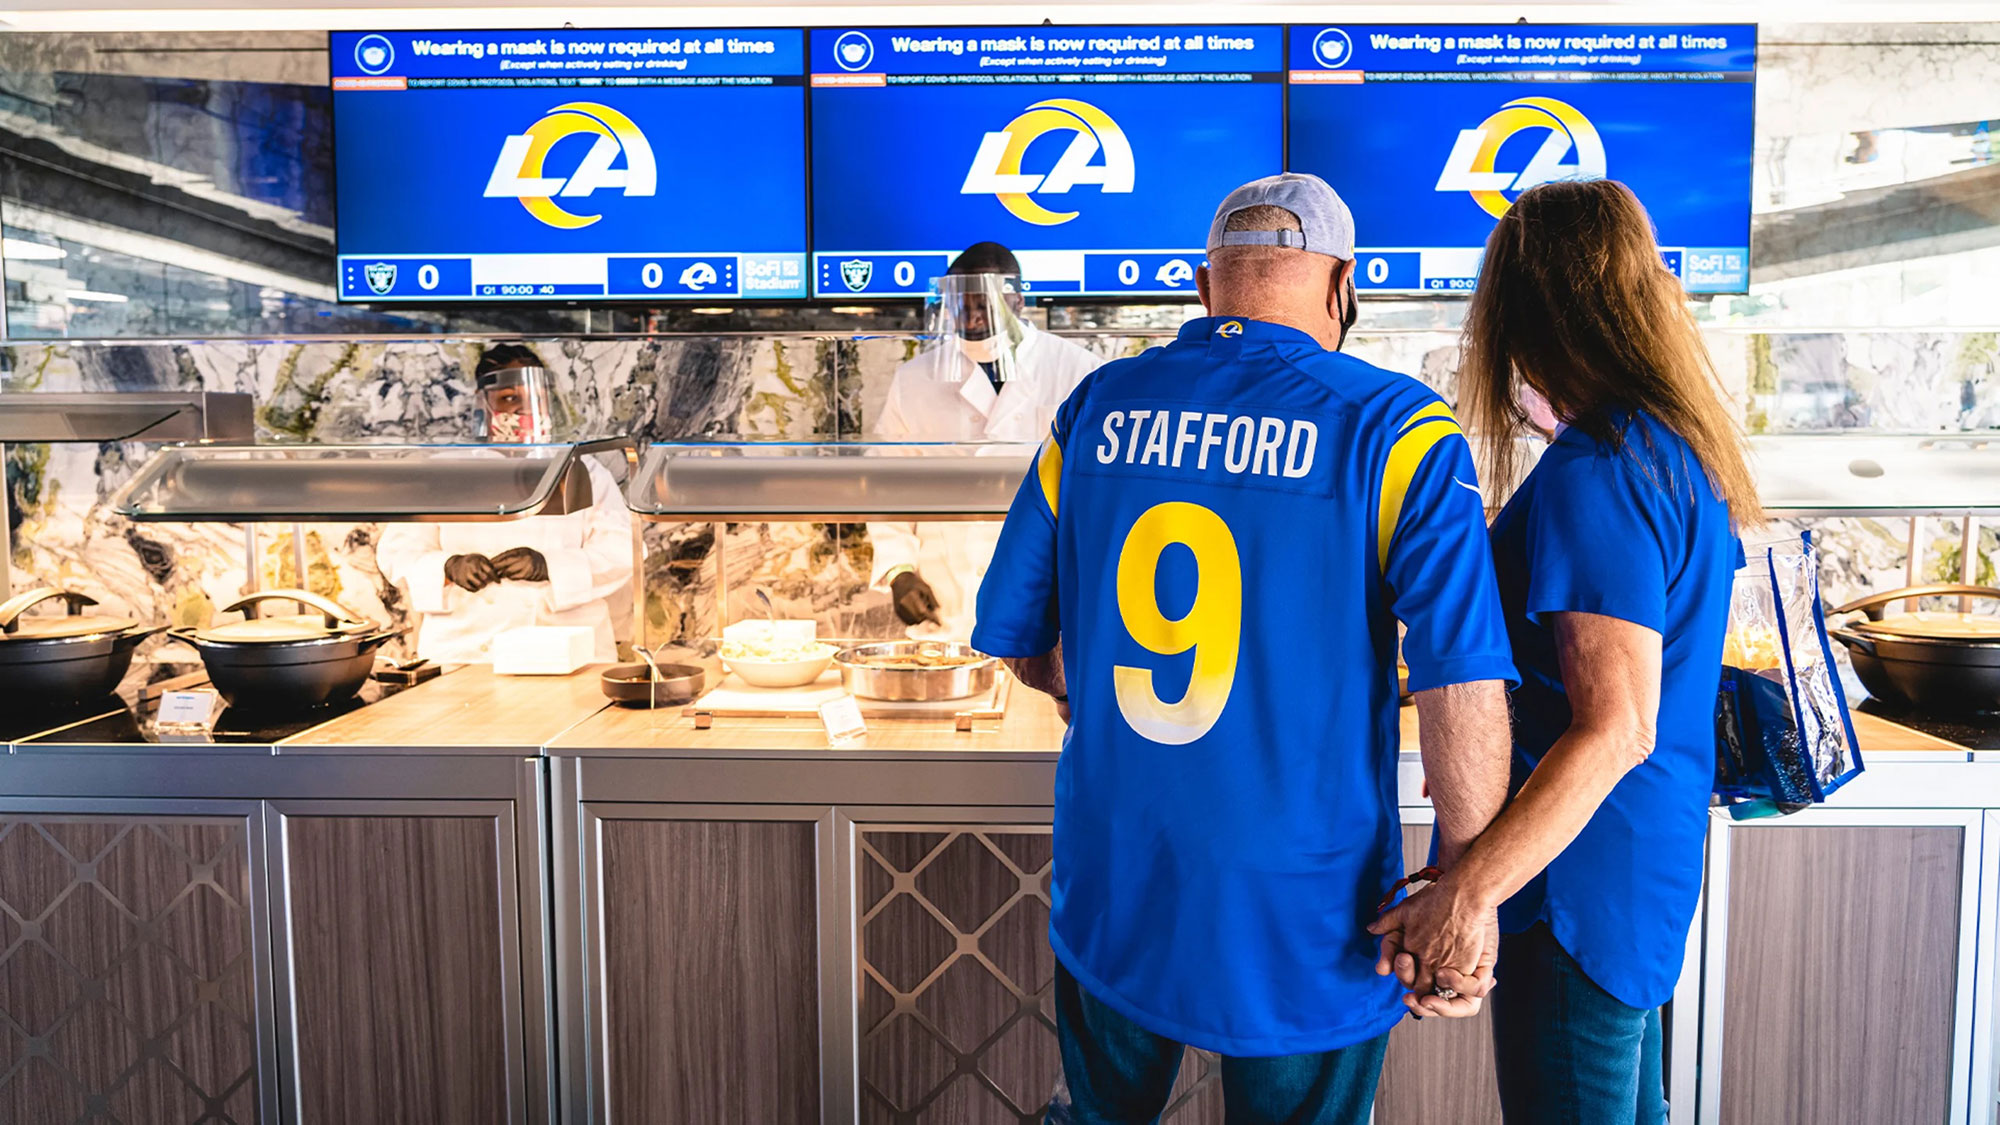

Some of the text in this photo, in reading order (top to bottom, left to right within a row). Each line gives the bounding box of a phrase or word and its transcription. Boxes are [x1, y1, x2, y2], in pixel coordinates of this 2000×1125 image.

[412, 39, 774, 59] Wearing a mask is now required at all times
[892, 36, 1254, 56] Wearing a mask is now required at all times
[1370, 34, 1728, 53] Wearing a mask is now required at all times
[745, 260, 780, 276] SoFi
[1118, 259, 1140, 285] 0
[1367, 257, 1389, 284] 0
[1688, 255, 1723, 270] SoFi
[418, 264, 440, 290] 0
[641, 262, 663, 288] 0
[745, 276, 801, 291] Stadium
[894, 261, 915, 287] 0
[1431, 279, 1477, 289] Q1 90:0
[501, 285, 533, 295] 90:00
[1096, 410, 1319, 479] STAFFORD
[1113, 501, 1242, 746] 9
